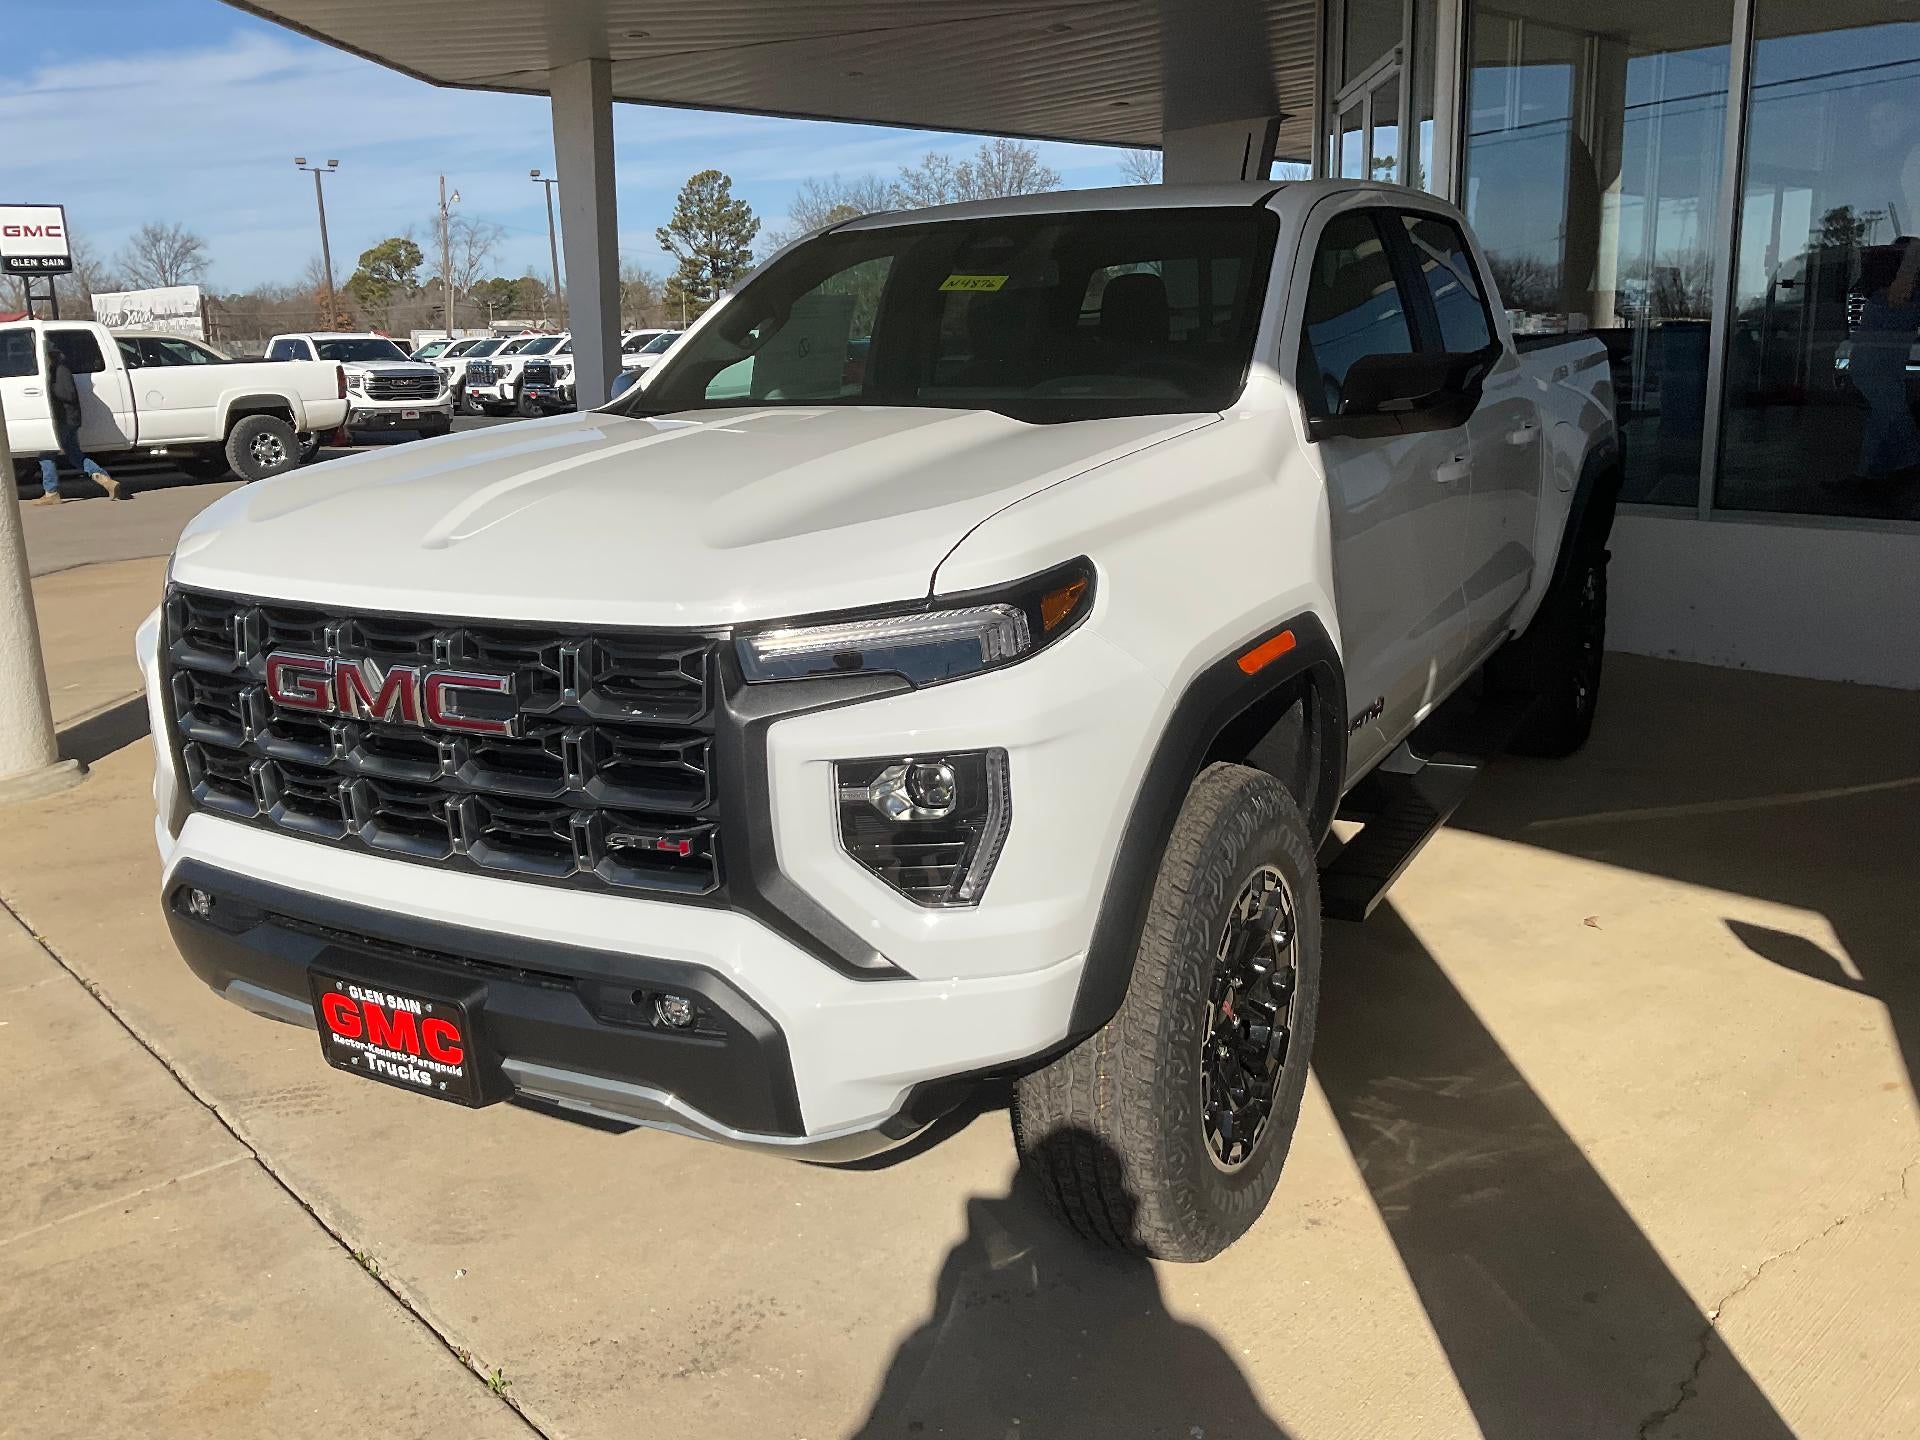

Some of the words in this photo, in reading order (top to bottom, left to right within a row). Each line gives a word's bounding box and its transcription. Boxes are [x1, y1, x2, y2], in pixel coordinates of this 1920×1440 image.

[3, 225, 62, 237] GMC
[10, 258, 38, 266] GLEN
[41, 258, 65, 266] SAIN
[266, 650, 517, 739] GMC
[348, 985, 385, 1004] GLEN
[386, 994, 422, 1015] SAIN
[322, 992, 464, 1065] GMC
[364, 1051, 433, 1087] Trucks
